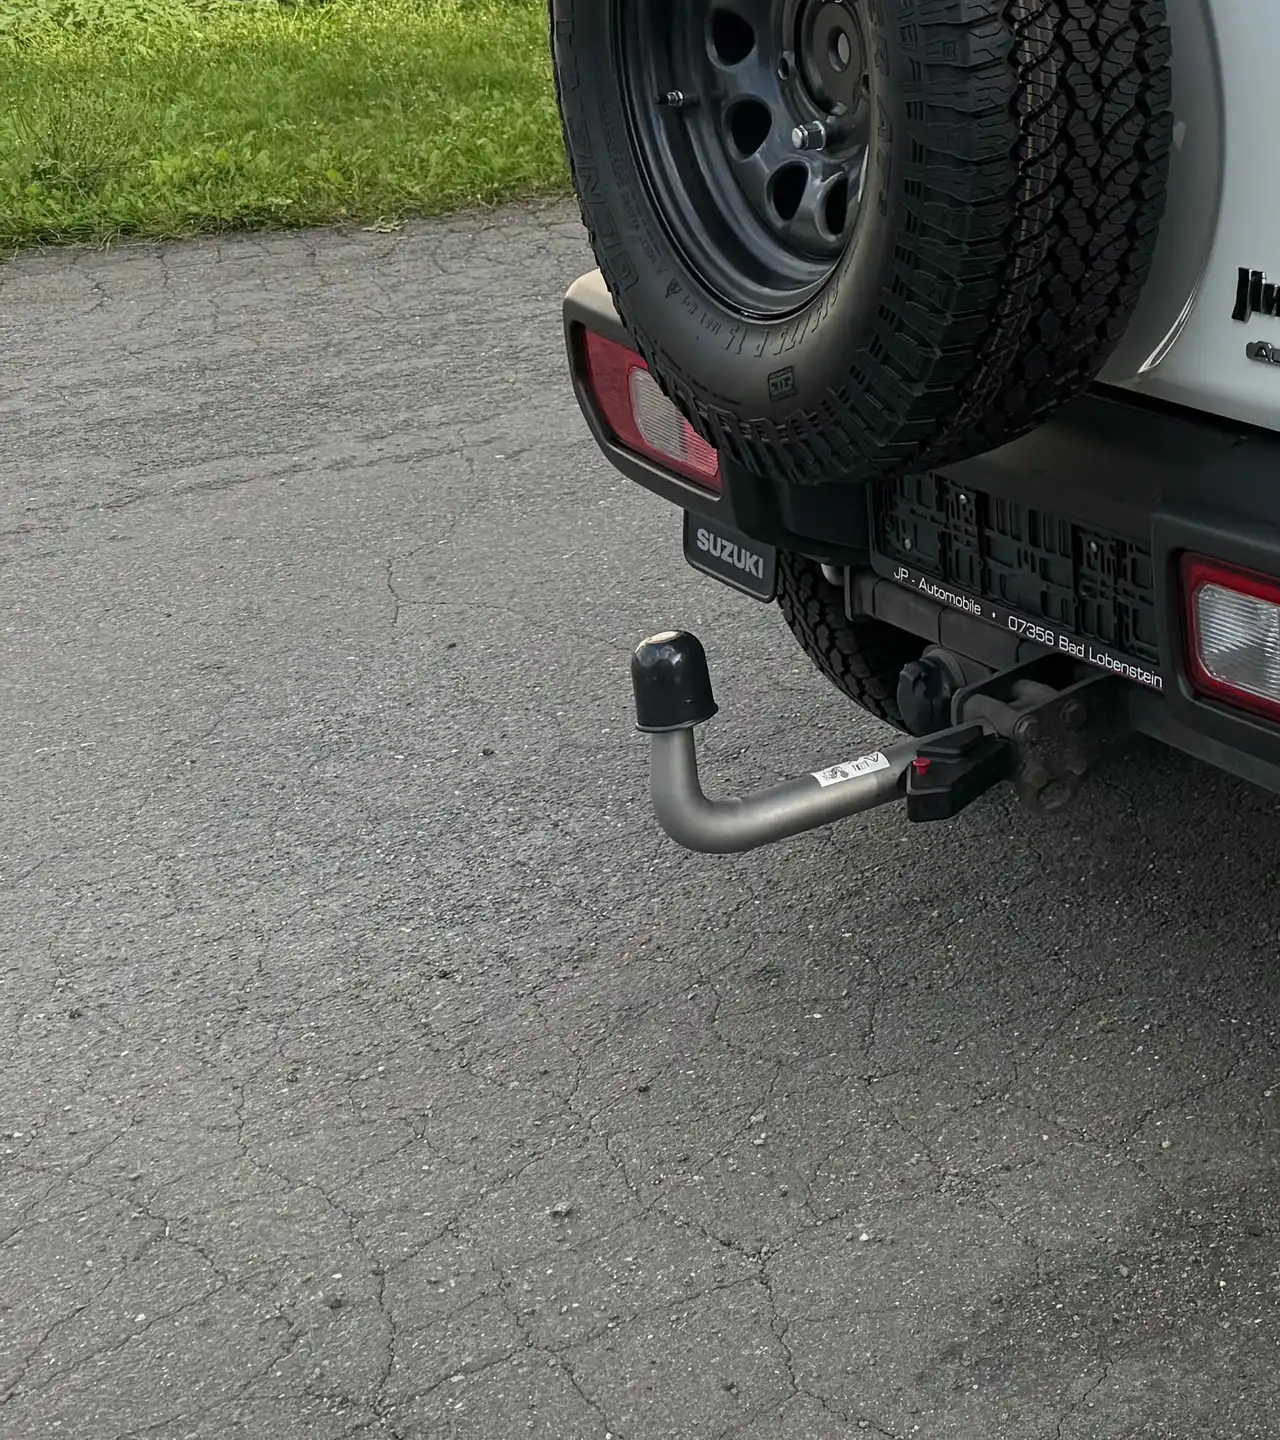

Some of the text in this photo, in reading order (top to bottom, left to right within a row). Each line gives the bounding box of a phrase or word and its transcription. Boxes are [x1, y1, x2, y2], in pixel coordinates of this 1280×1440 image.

[696, 528, 764, 579] SUZUKI
[893, 566, 909, 581] JP
[918, 577, 982, 616] Automobile
[1008, 615, 1055, 646] 07356
[1058, 635, 1085, 657] Bad
[1089, 646, 1163, 689] Lobenstein
